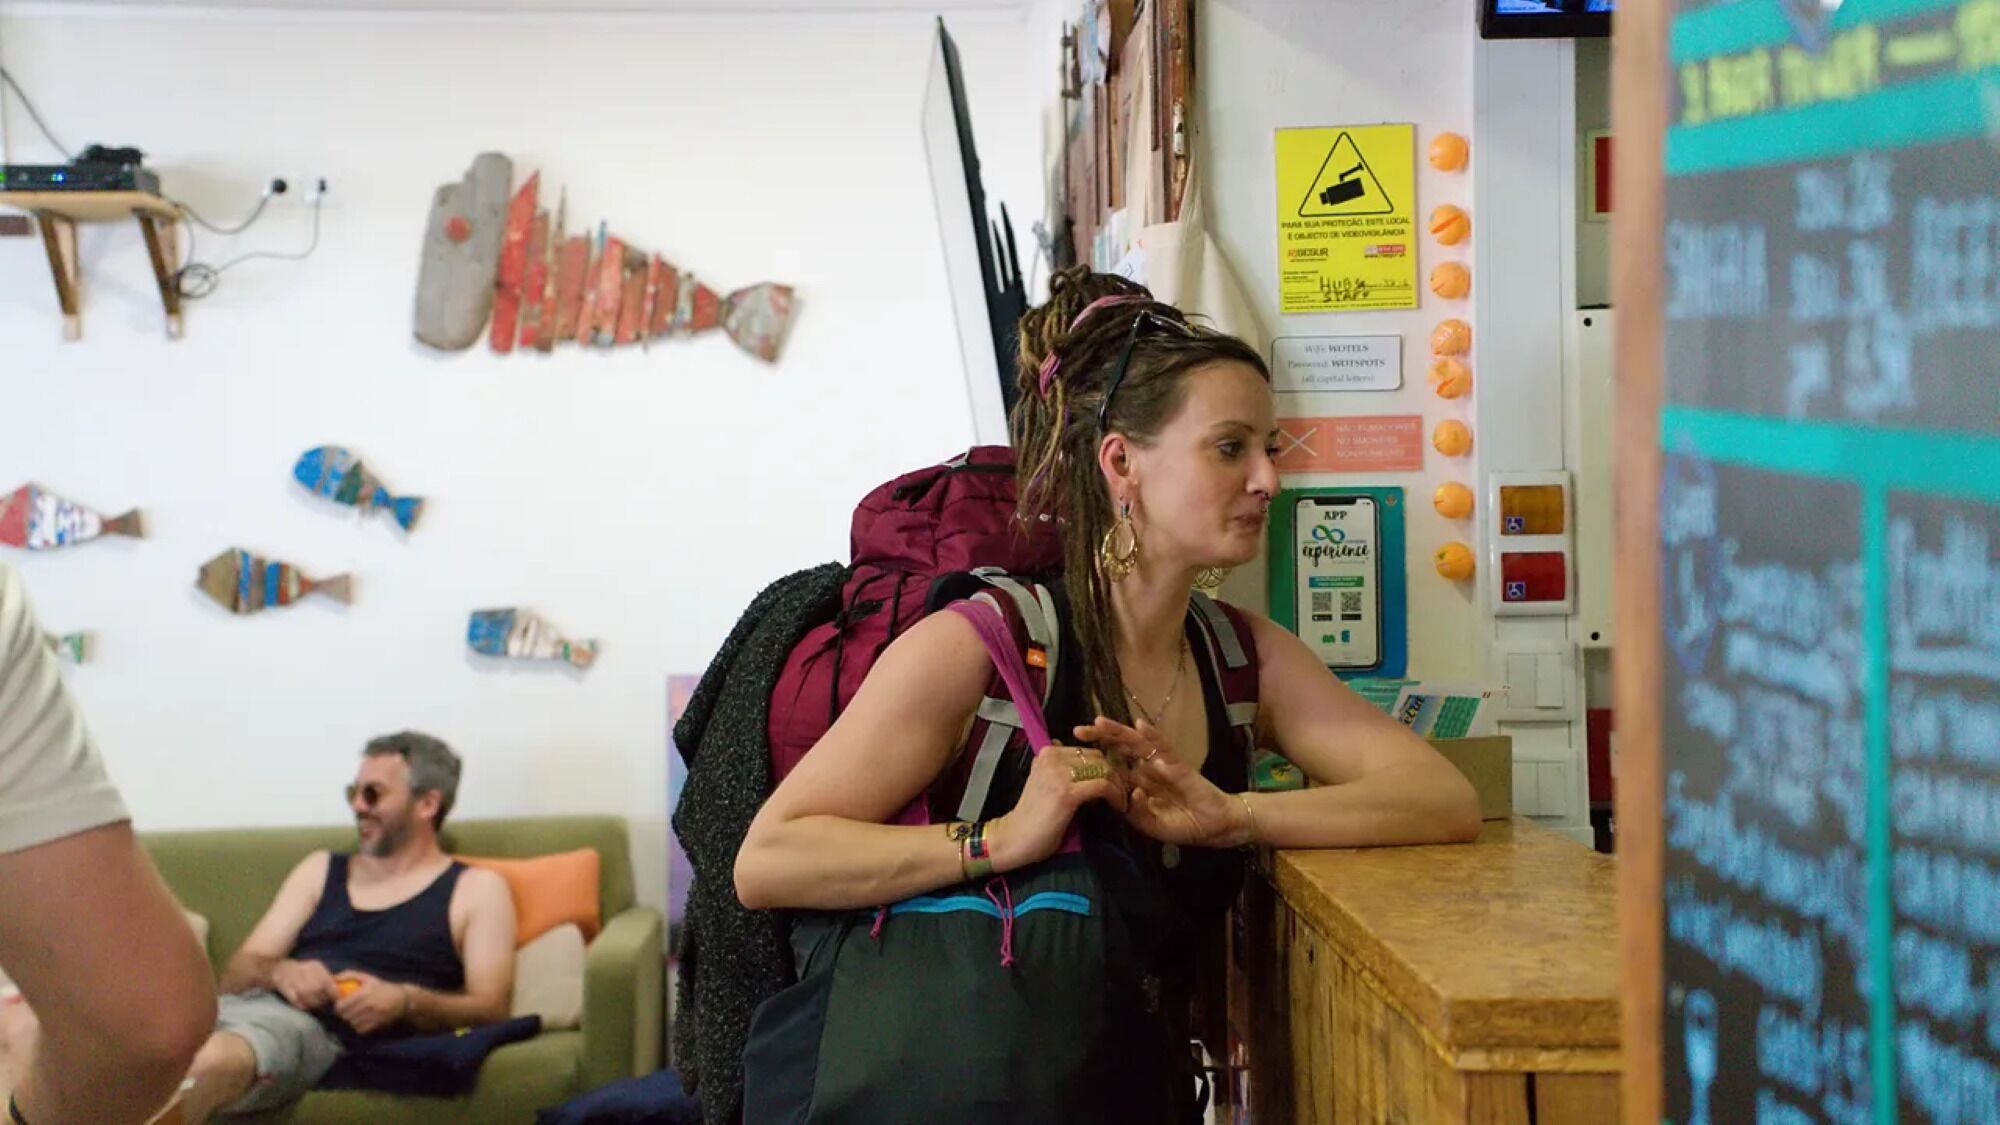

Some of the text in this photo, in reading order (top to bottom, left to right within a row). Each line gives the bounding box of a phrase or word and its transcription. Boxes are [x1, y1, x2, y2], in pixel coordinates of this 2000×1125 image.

[1281, 221, 1302, 229] PARA
[1304, 220, 1321, 228] SUA
[1366, 218, 1384, 226] ESTE
[1386, 217, 1410, 225] LOCAL
[1294, 231, 1328, 240] OBJECTO
[1328, 344, 1369, 352] WOTELS
[1288, 359, 1386, 368] Password: WOTSPOTS
[1316, 374, 1345, 384] capital
[1336, 436, 1398, 445] NO SMOKERS
[1324, 511, 1347, 520] APP
[1302, 544, 1369, 567] experience
